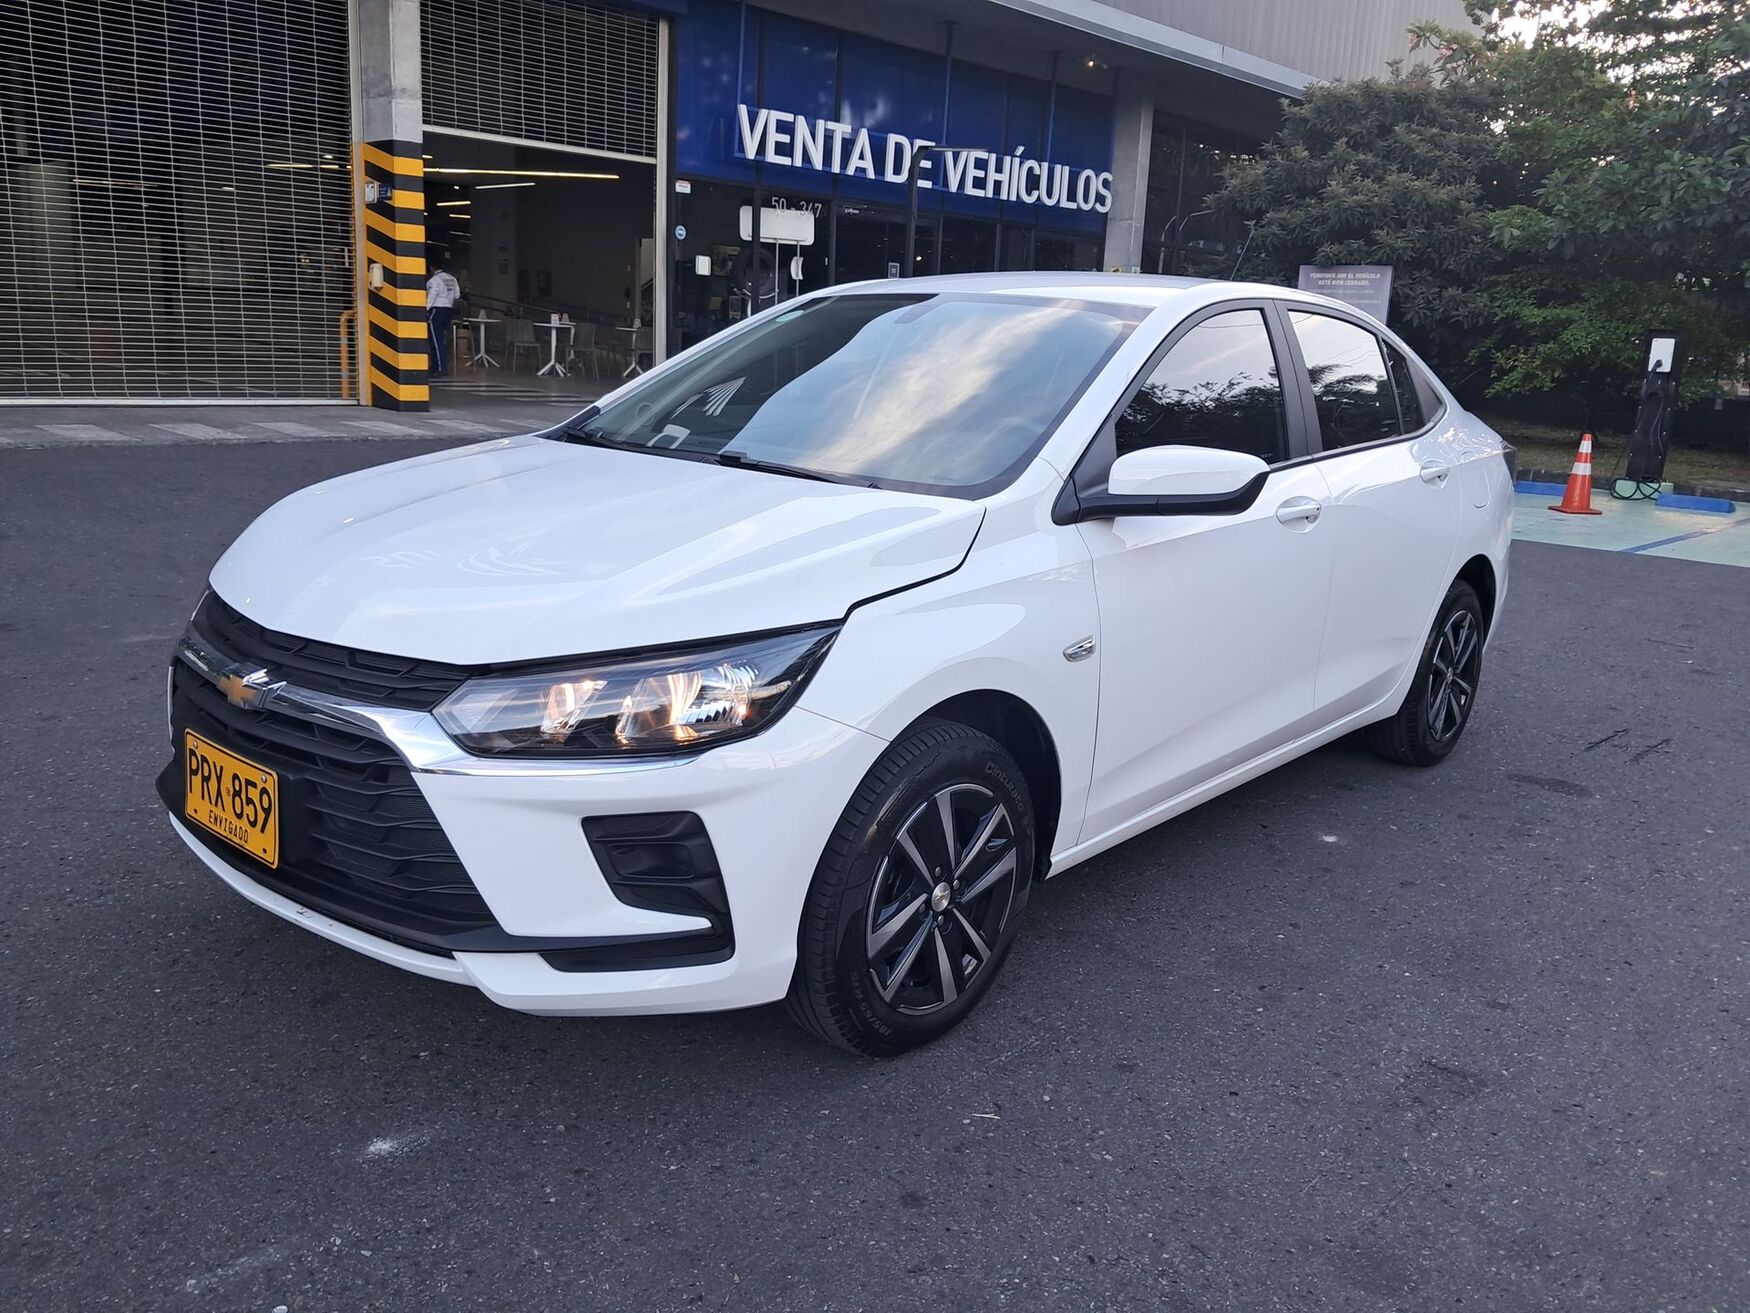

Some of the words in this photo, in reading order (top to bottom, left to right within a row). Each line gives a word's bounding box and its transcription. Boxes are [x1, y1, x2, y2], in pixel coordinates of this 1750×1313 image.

[738, 104, 875, 179] VENTA
[885, 133, 936, 188] DE
[945, 145, 1113, 214] VEHÍCULOS
[771, 196, 787, 214] 50
[188, 747, 226, 813] PRX
[231, 772, 273, 834] 859
[208, 809, 249, 844] ENVIGADO
